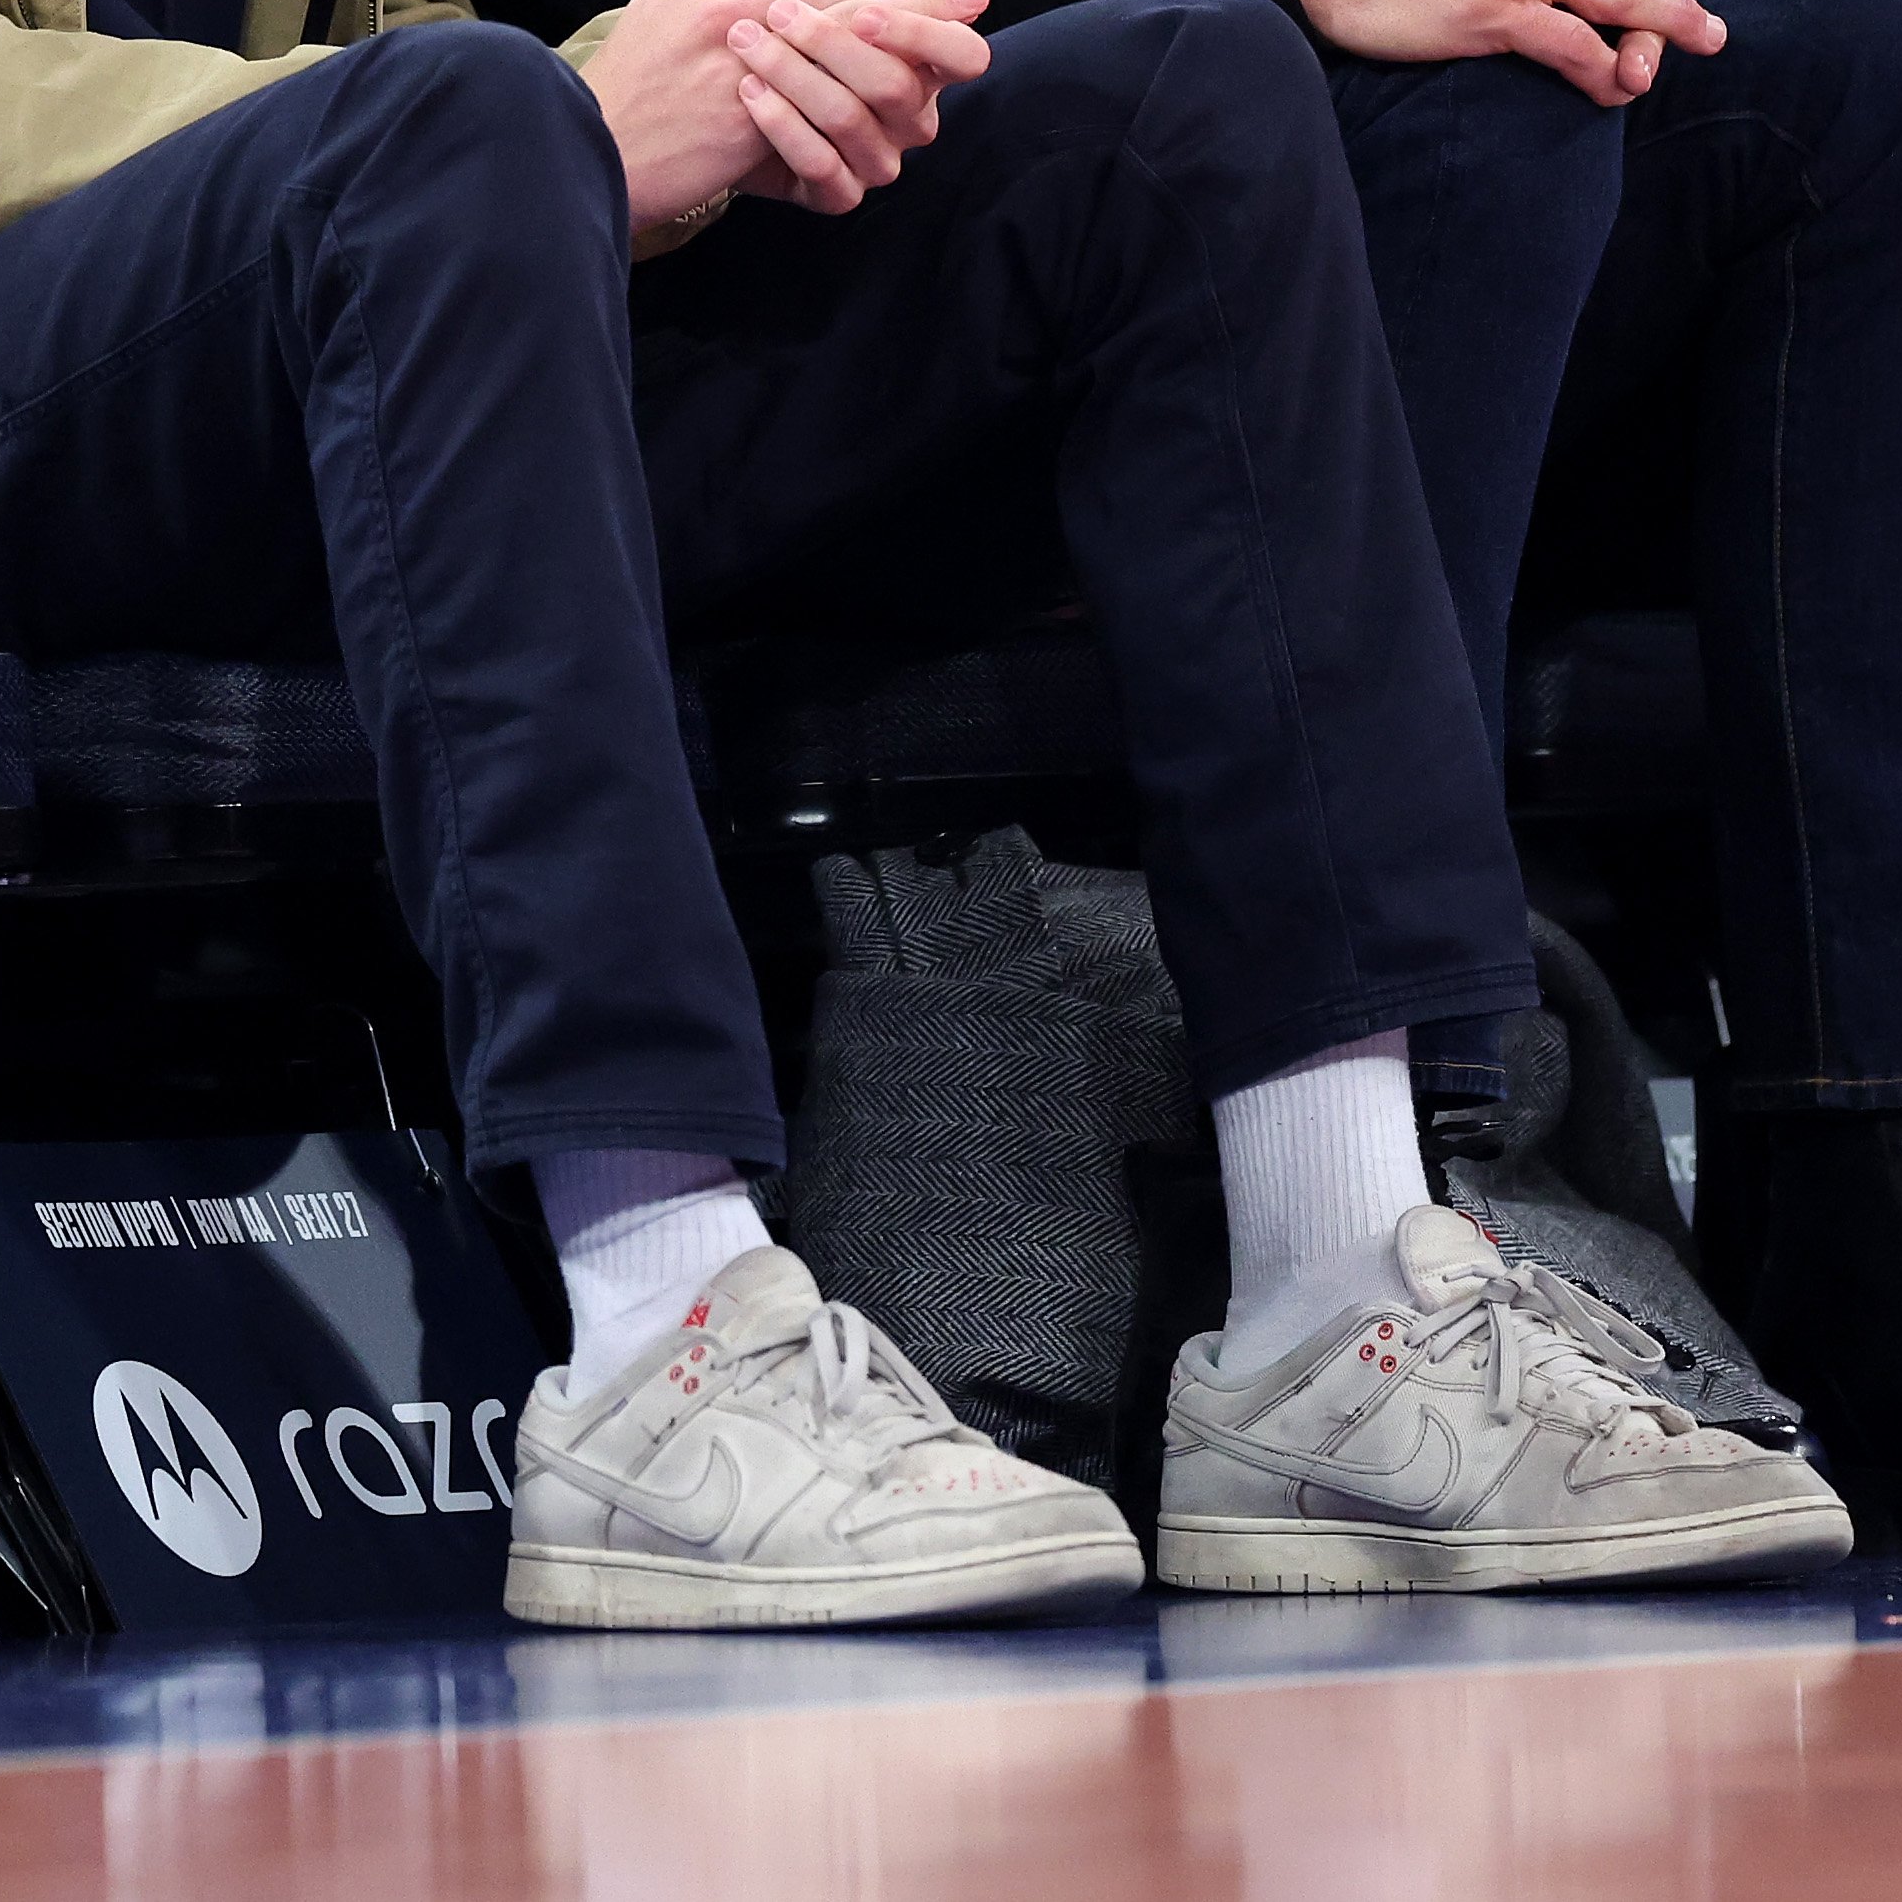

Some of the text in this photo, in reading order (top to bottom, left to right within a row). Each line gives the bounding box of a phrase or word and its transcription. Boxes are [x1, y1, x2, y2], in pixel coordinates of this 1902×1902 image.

[35, 1191, 369, 1249] SECTION VIP10 ROW AA SEAT 27
[279, 1397, 513, 1521] razr
